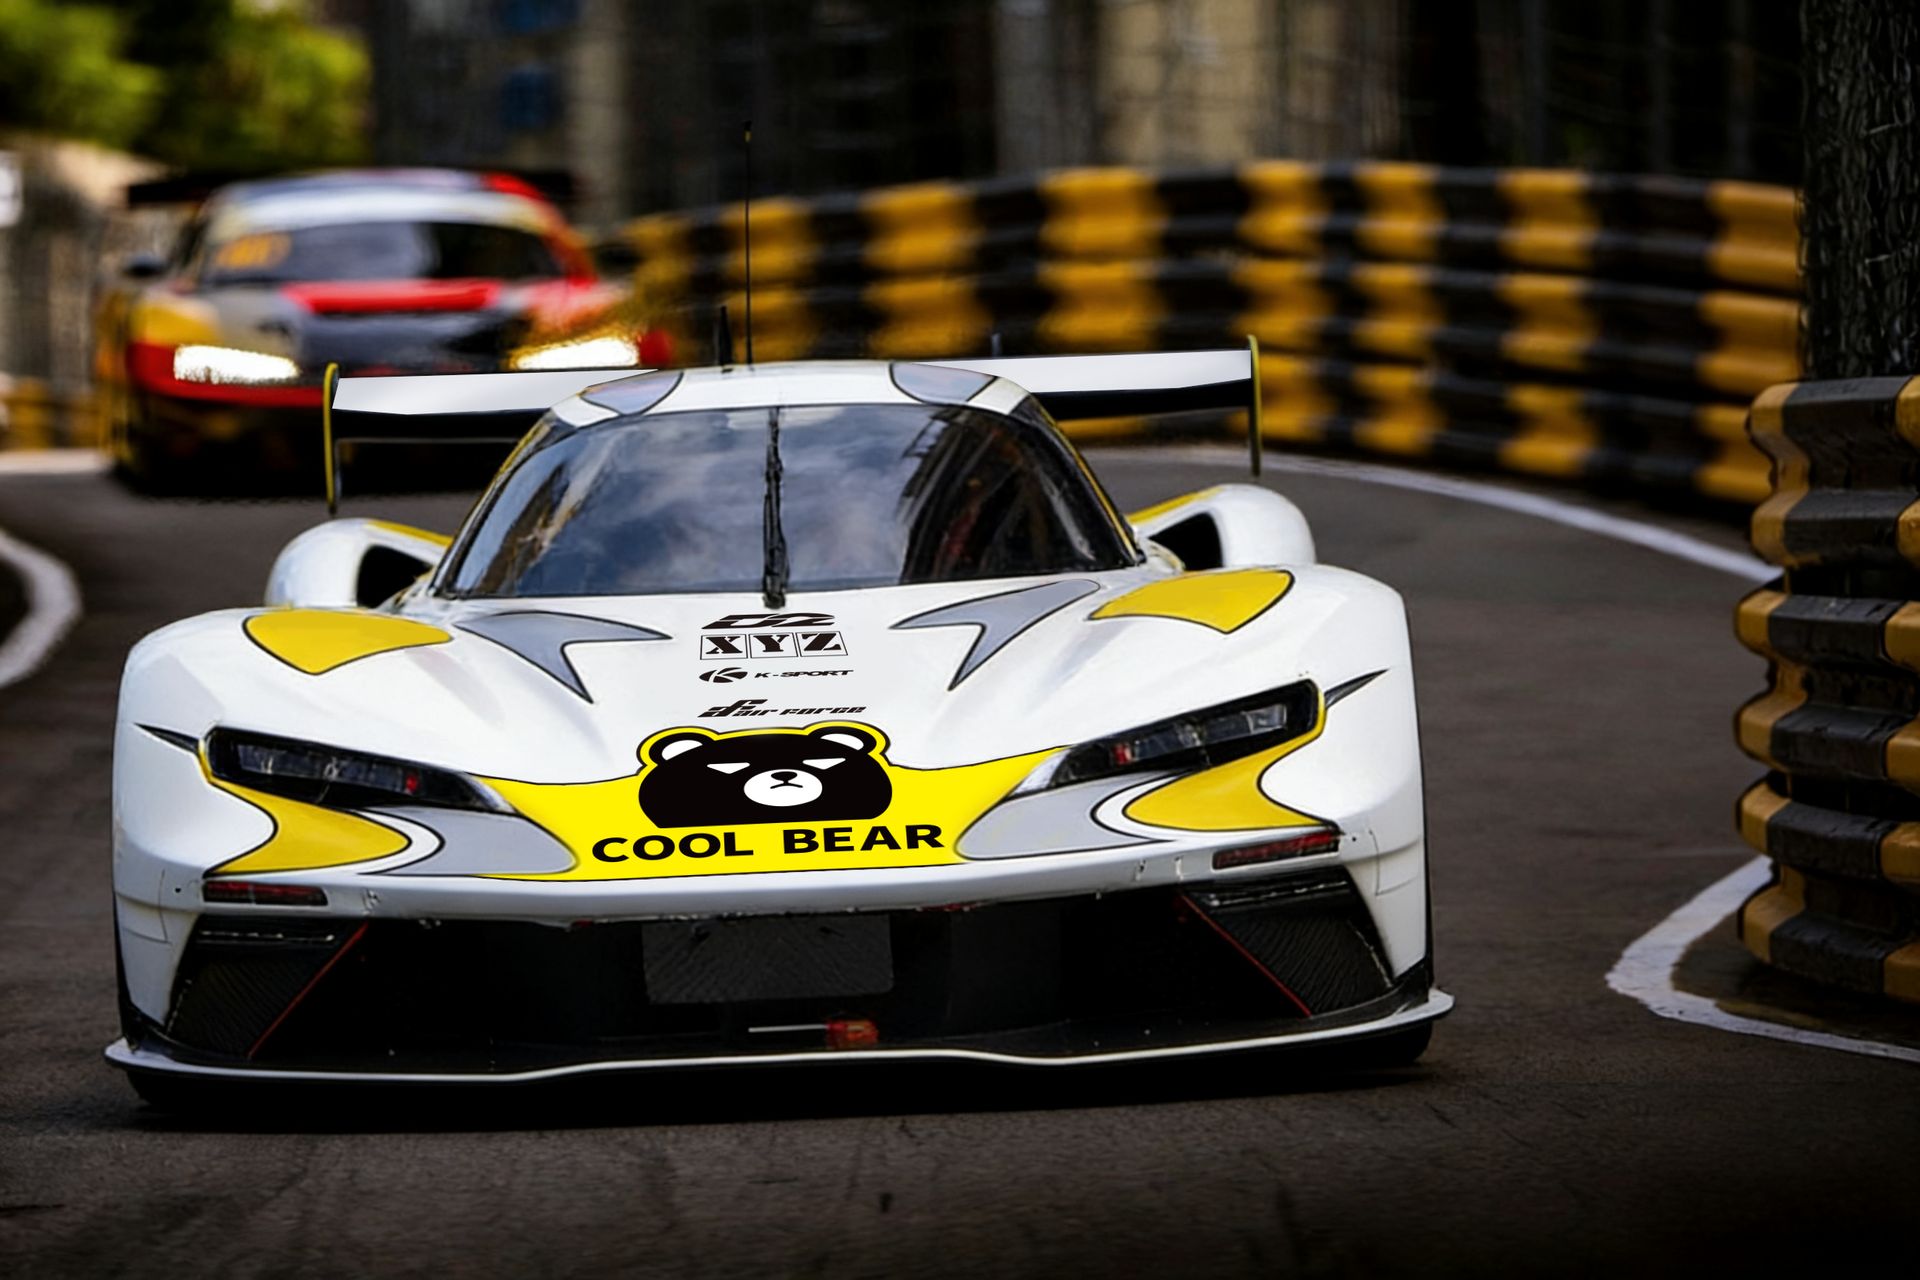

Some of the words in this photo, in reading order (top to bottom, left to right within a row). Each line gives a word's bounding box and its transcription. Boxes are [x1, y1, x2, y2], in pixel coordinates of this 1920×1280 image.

[703, 632, 844, 656] XYZ
[592, 831, 753, 862] COOL
[783, 824, 944, 854] BEAR
